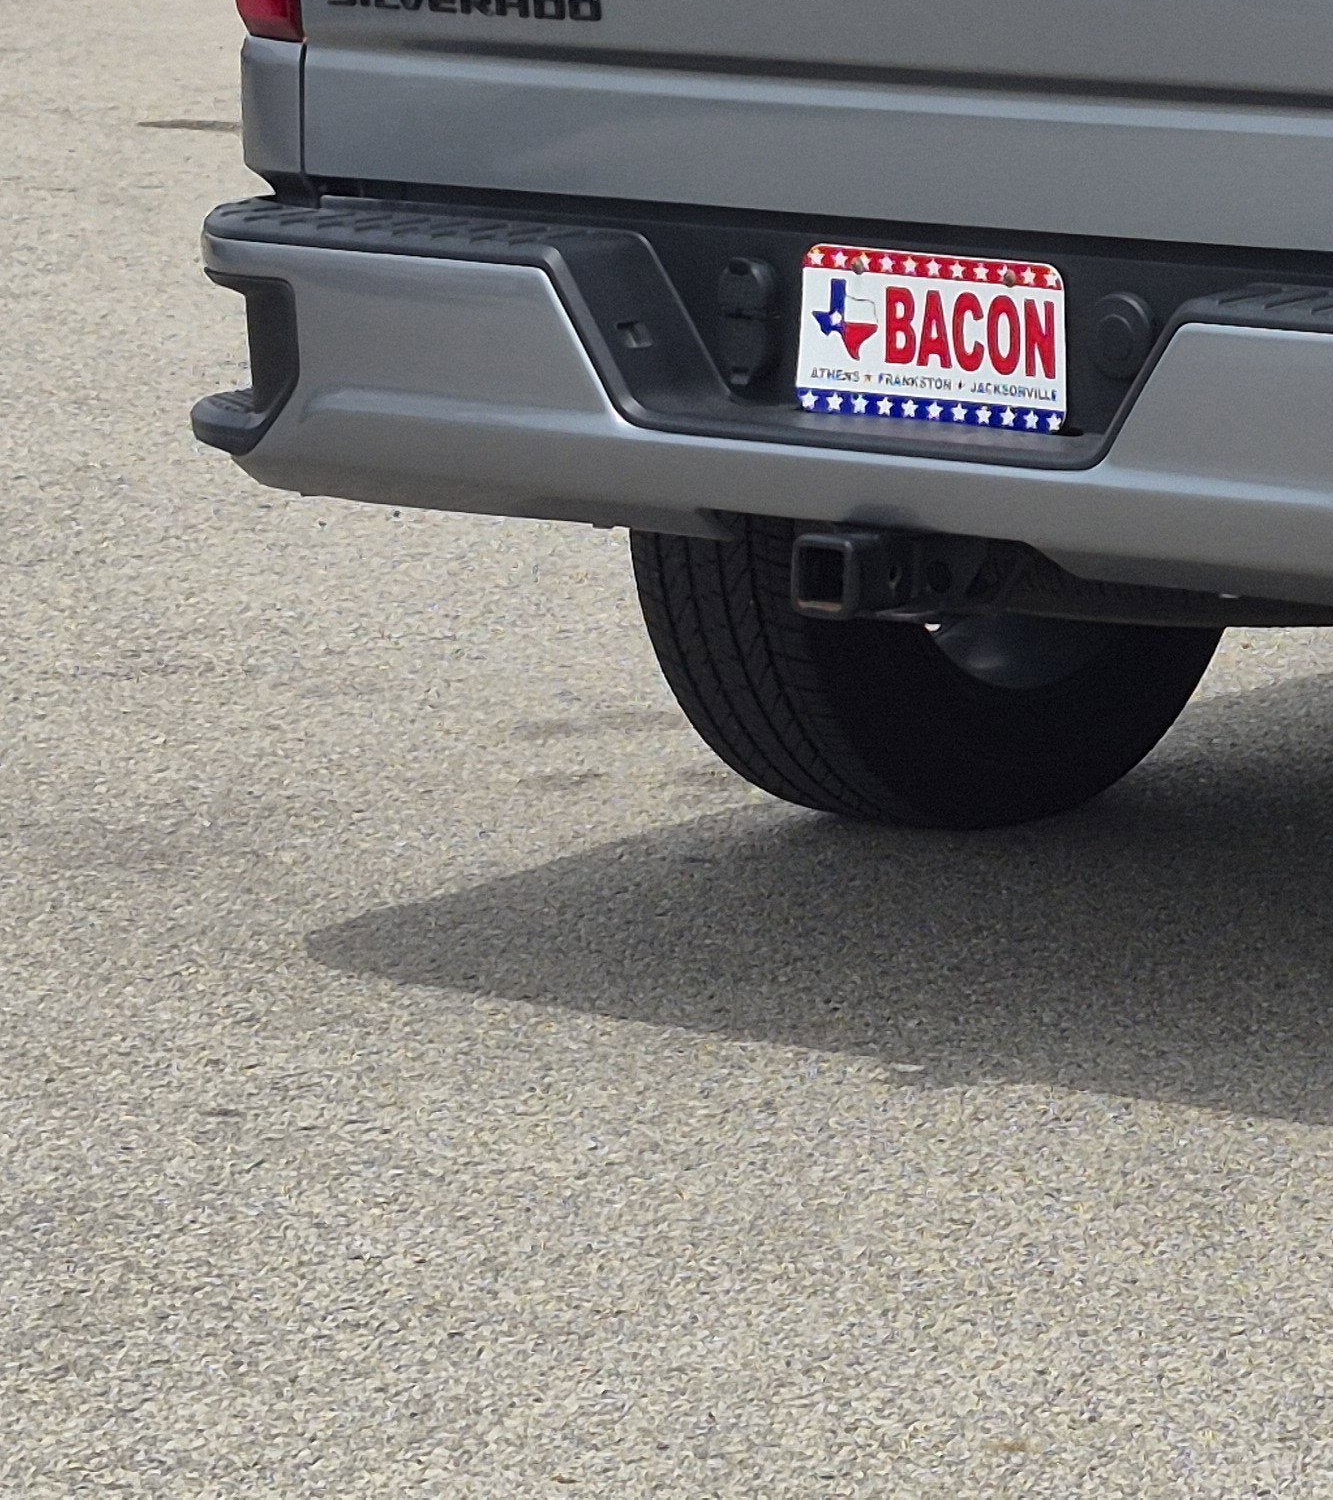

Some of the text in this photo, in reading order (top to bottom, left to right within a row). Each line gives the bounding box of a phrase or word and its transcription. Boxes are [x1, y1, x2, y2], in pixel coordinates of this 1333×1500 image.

[884, 286, 1056, 380] BACON
[810, 366, 1057, 402] ATHENS FRANKSTON JACKSONVILLE
